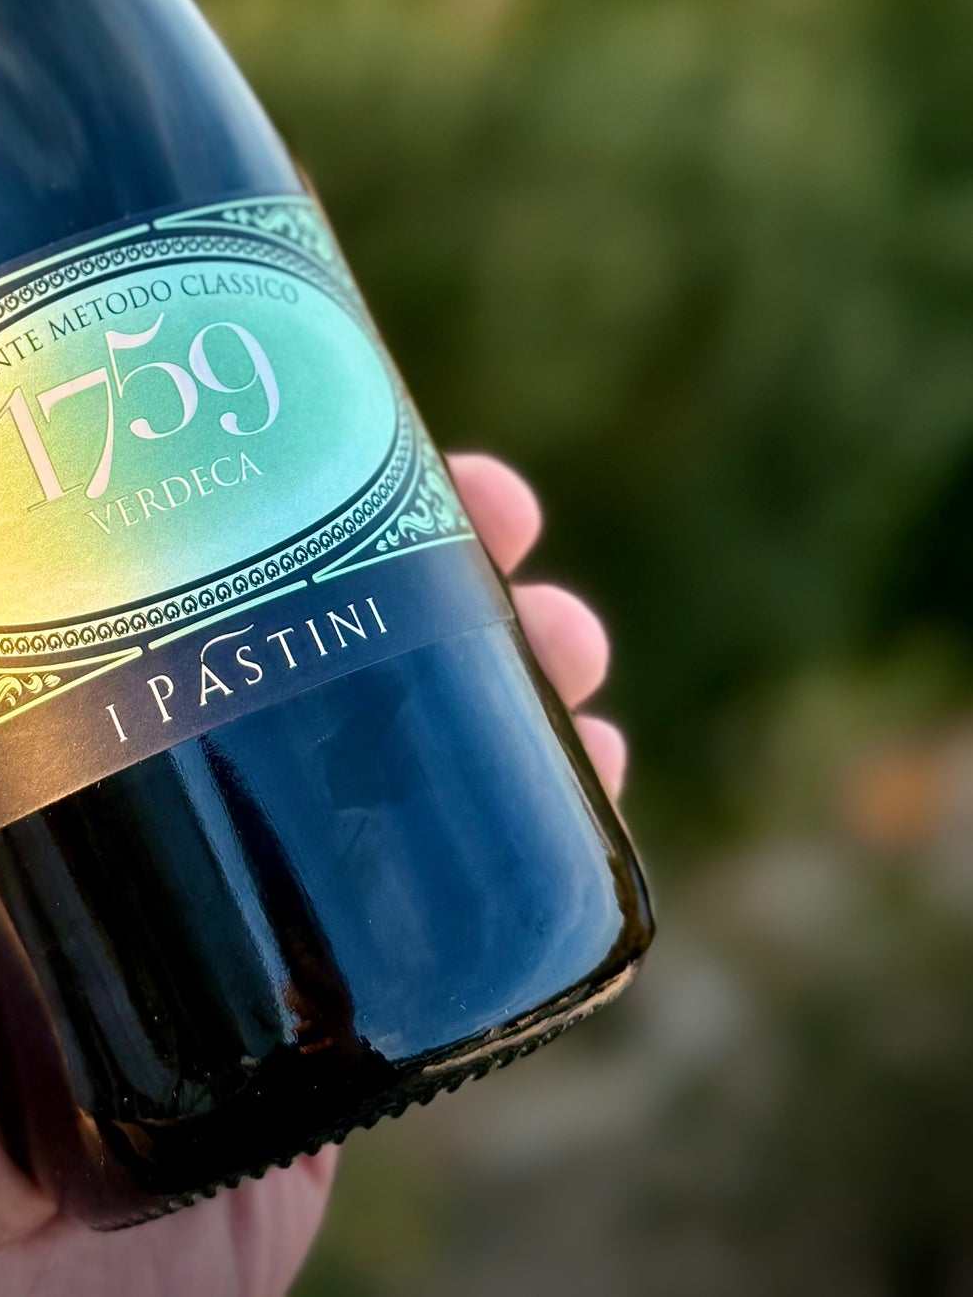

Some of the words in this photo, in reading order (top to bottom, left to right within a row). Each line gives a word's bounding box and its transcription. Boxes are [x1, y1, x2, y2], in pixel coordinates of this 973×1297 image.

[48, 279, 173, 343] METODO
[180, 273, 300, 305] CLASSICO
[87, 451, 265, 536] VERDECA
[105, 703, 128, 743] I
